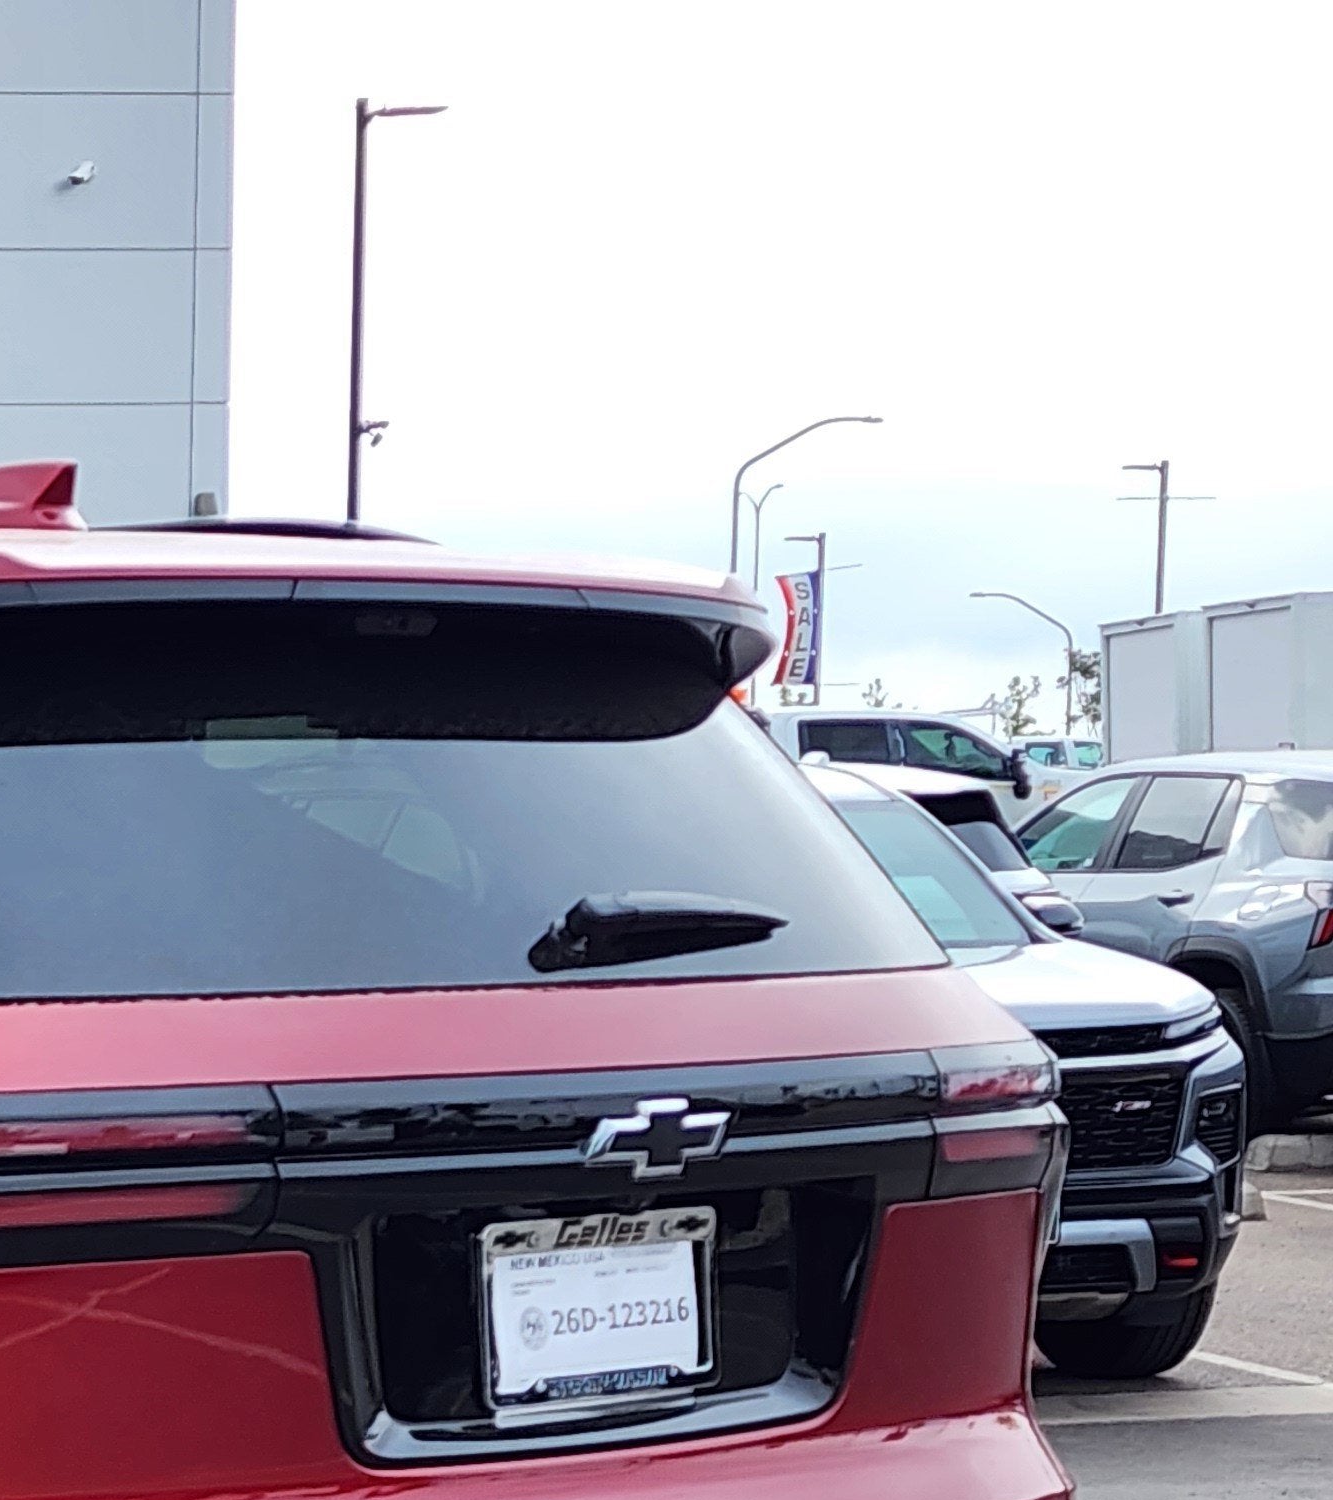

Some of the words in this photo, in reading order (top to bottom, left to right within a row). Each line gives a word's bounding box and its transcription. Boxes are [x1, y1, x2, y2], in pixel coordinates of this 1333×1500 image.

[789, 582, 811, 677] SALE
[553, 1216, 650, 1249] Galles
[552, 1297, 689, 1335] 26D-123216
